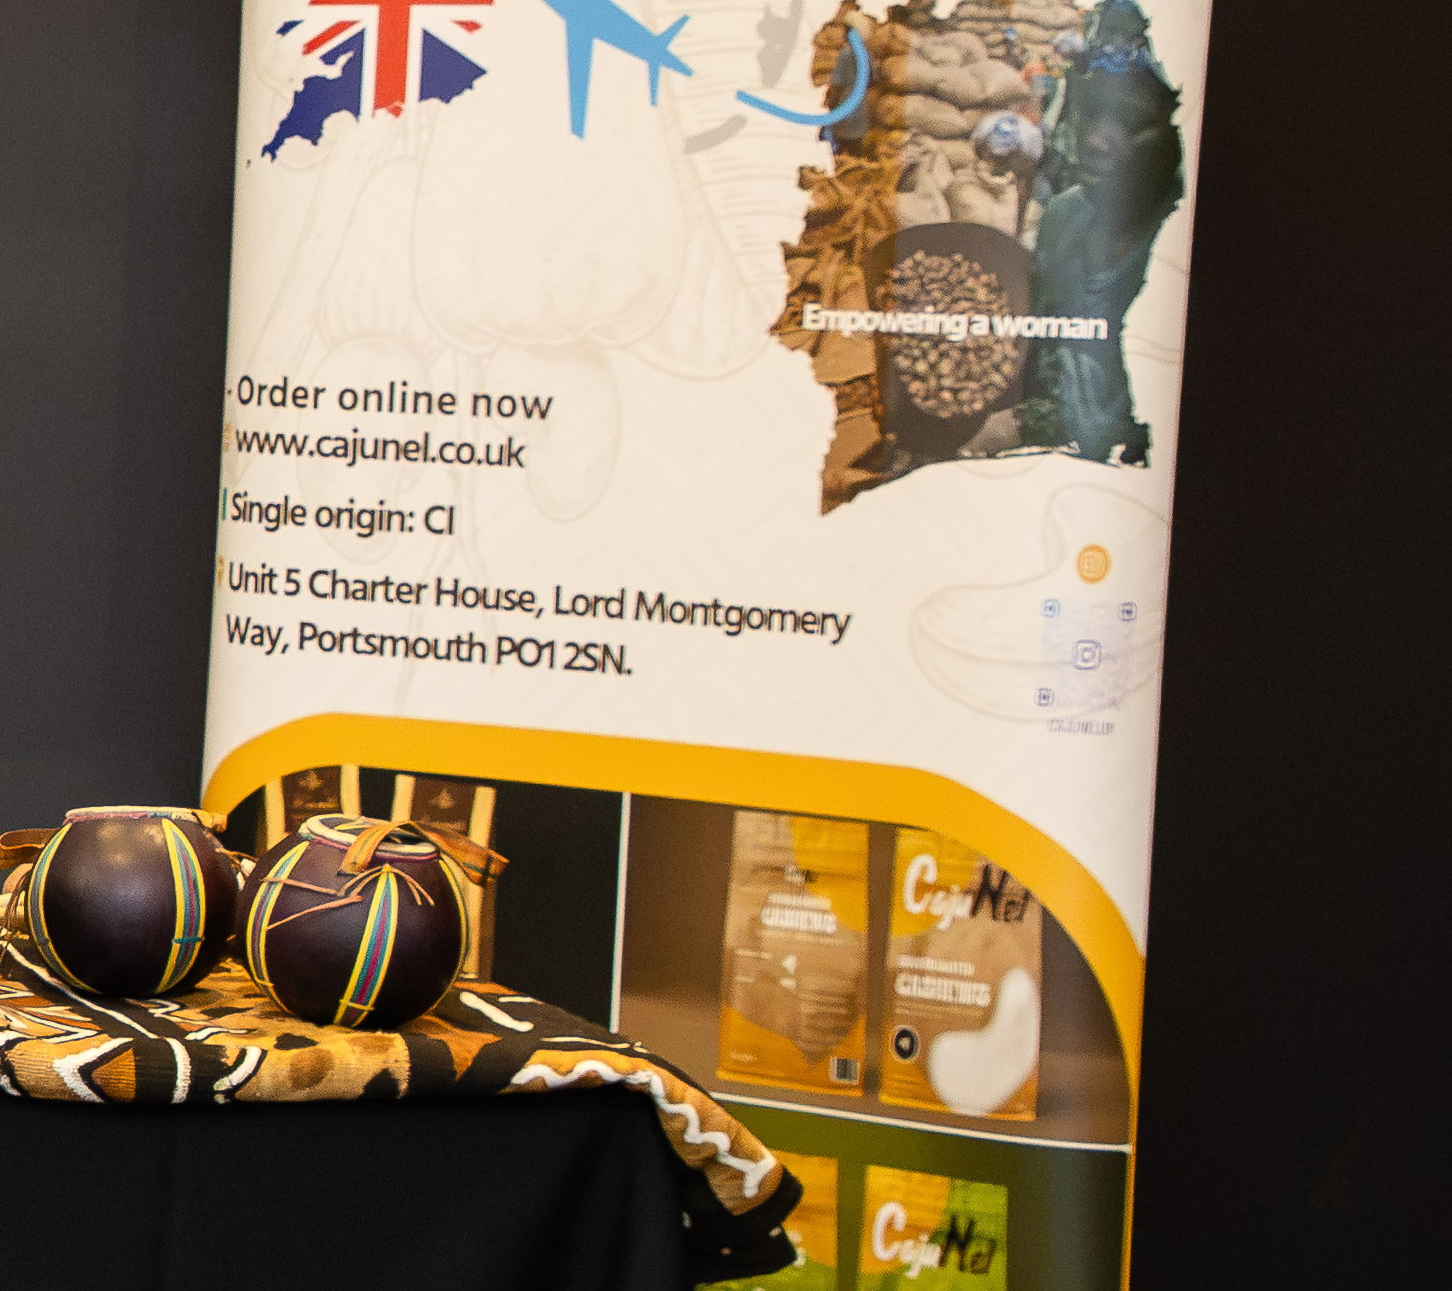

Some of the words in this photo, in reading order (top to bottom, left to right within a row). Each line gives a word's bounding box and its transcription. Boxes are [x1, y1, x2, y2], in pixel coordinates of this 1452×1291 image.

[801, 302, 964, 341] Empowering
[970, 315, 989, 338] a
[991, 313, 1108, 340] woman
[237, 375, 326, 409] Order
[338, 381, 456, 415] online
[472, 394, 553, 420] now
[235, 428, 525, 468] www.cajunel.co.uk
[231, 491, 307, 532] Single
[315, 498, 414, 538] origin:
[229, 562, 278, 595] Unit
[284, 568, 300, 596] 5
[309, 569, 428, 604] Charter
[436, 577, 543, 619] House,
[555, 585, 626, 619] Lord
[634, 591, 851, 645] Montgomery
[226, 614, 289, 655] Way,
[299, 622, 486, 664] Portsmouth
[496, 636, 554, 669] PO1
[563, 642, 632, 675] 2SN.
